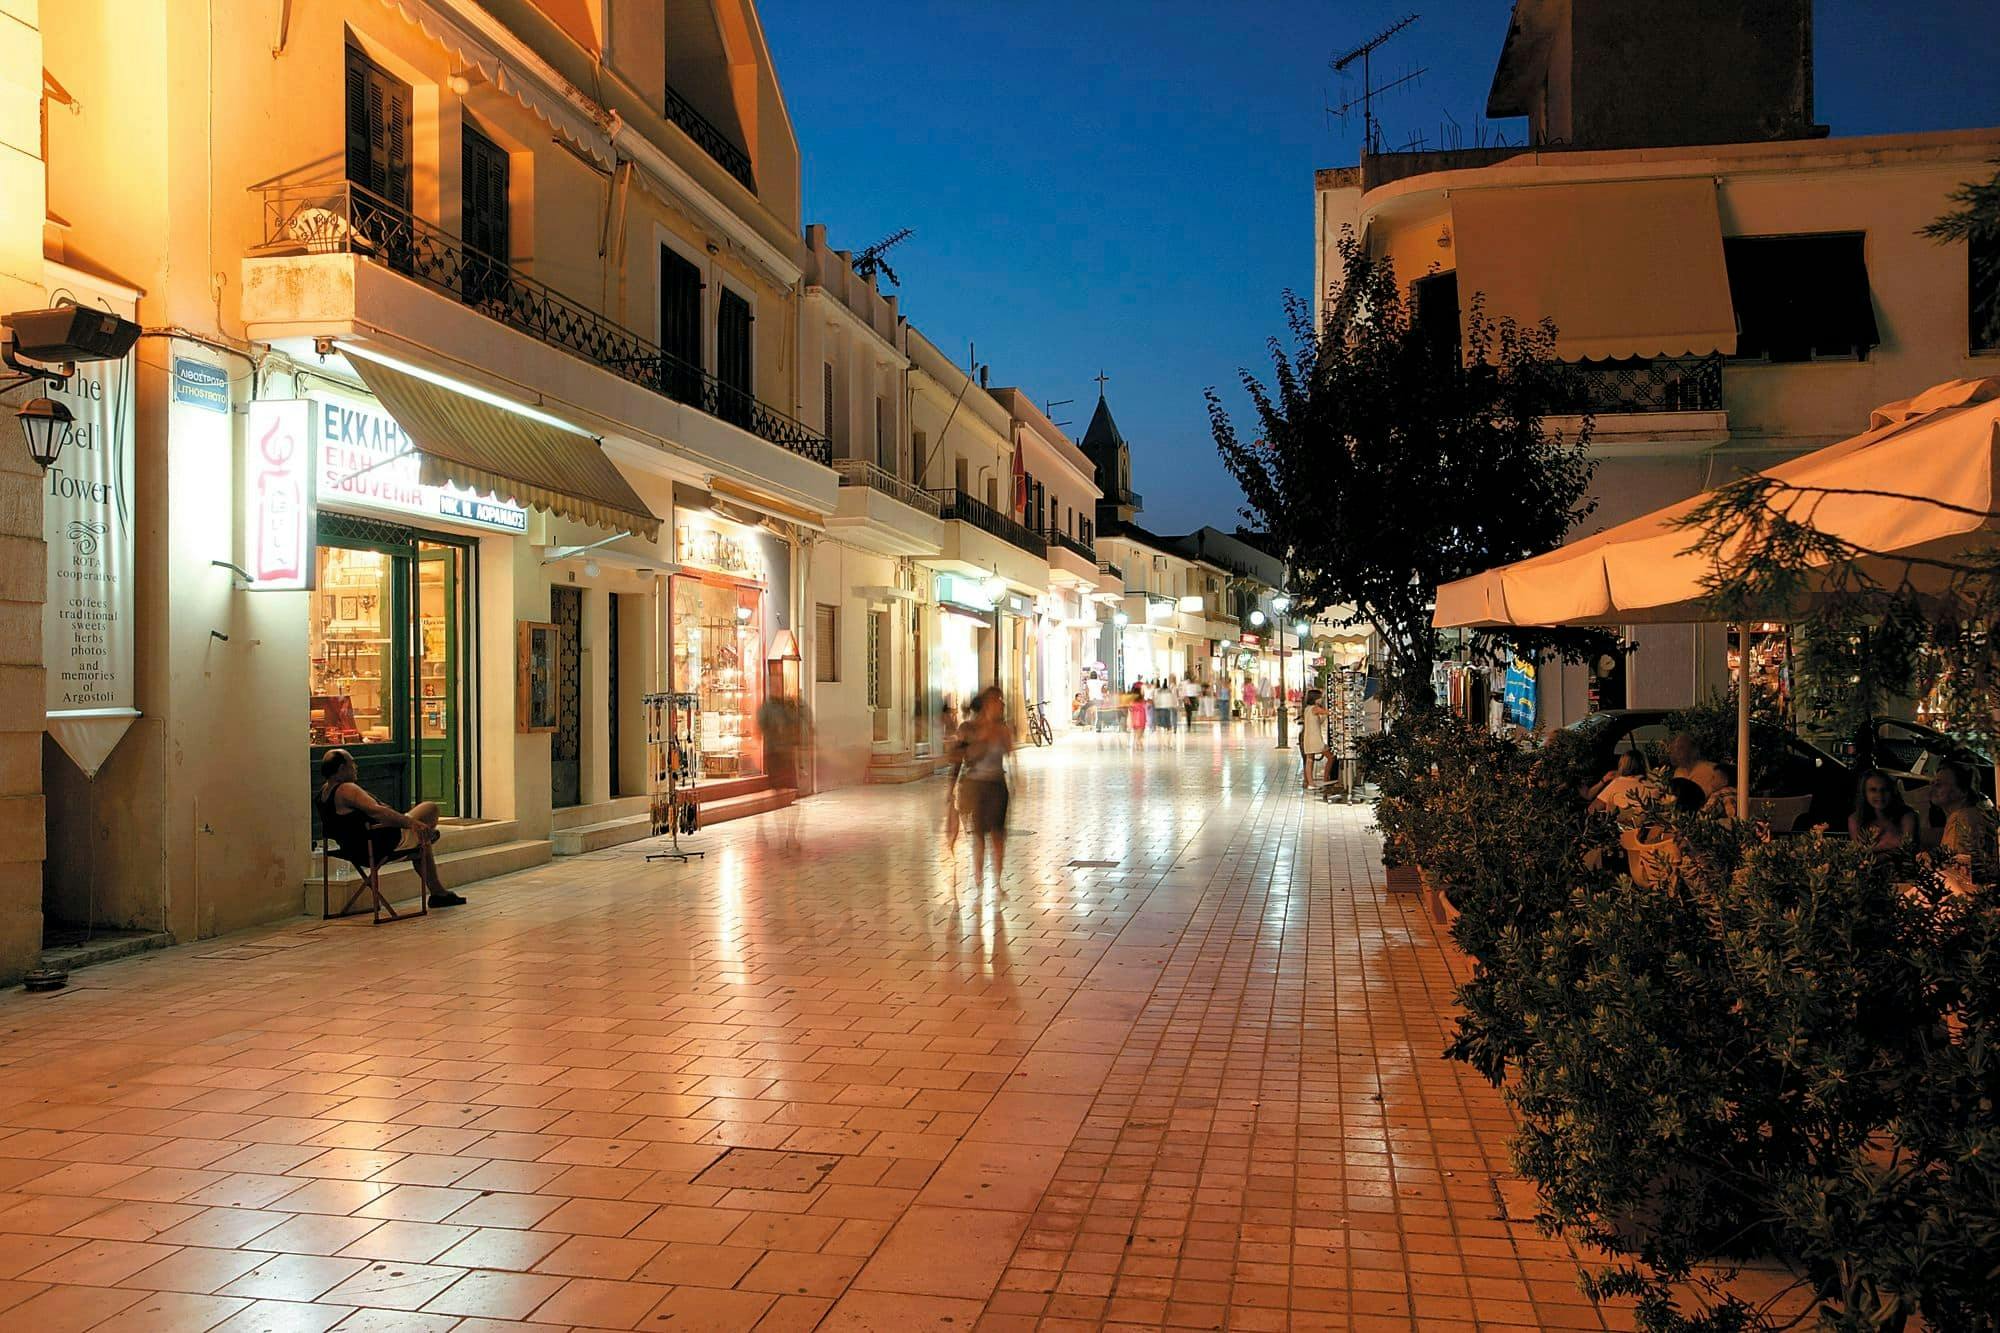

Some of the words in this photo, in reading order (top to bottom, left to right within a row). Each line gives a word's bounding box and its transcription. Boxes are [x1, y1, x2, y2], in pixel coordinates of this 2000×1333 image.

[177, 384, 227, 403] LITHOSTROTO
[325, 403, 411, 455] ΕΚΚΛΗΣ
[48, 466, 112, 504] Tower
[73, 556, 101, 567] ROTA
[57, 569, 117, 583] cooperative
[69, 597, 107, 608] coffees
[59, 610, 117, 622] traditional
[71, 621, 106, 631] sweets
[74, 632, 103, 643] herbs
[71, 645, 107, 657] photos
[79, 660, 98, 671] and
[61, 670, 115, 681] memories
[83, 681, 93, 692] of
[63, 691, 114, 704] Argostoli
